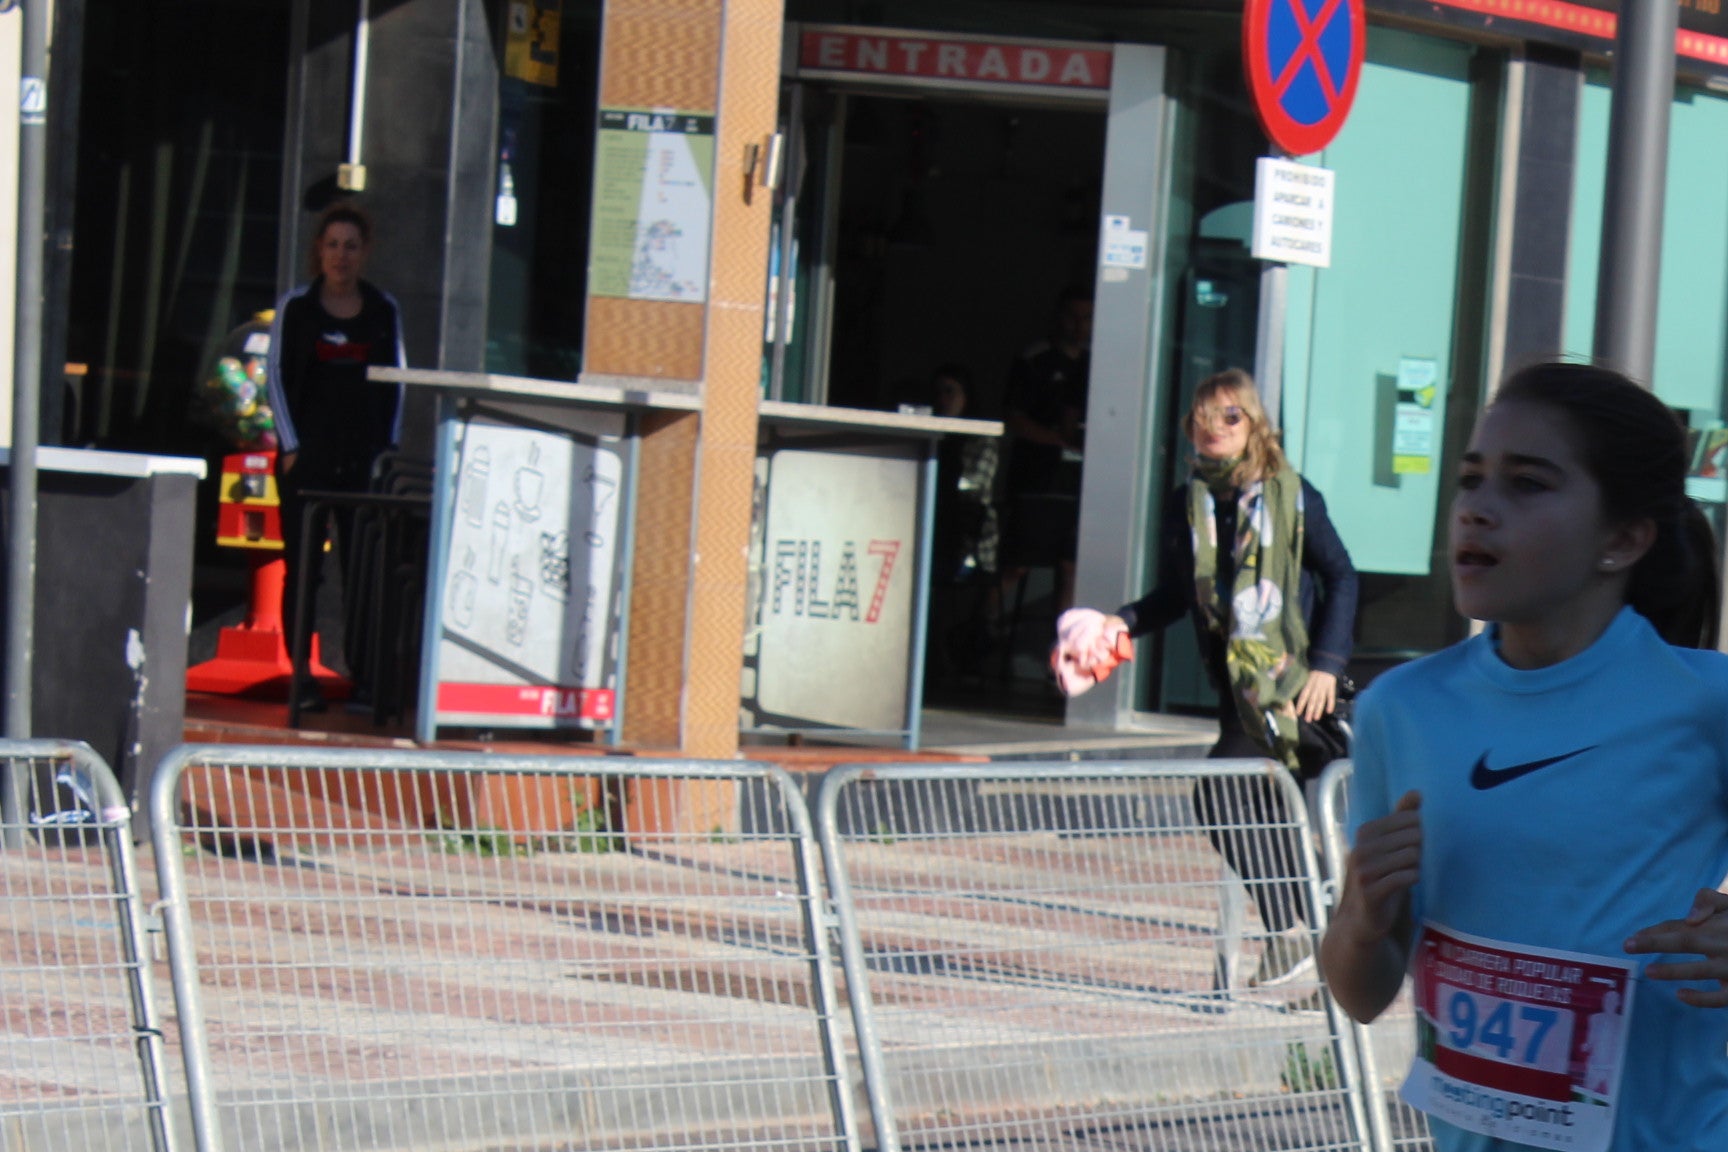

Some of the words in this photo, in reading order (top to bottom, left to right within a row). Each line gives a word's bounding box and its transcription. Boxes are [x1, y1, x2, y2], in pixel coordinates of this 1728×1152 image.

[819, 36, 1093, 84] ENTRADA
[1496, 975, 1574, 1005] ROQUETAS
[1513, 957, 1584, 984] POPULAR
[1449, 990, 1559, 1065] 947
[1431, 1075, 1576, 1128] meetingpoint
